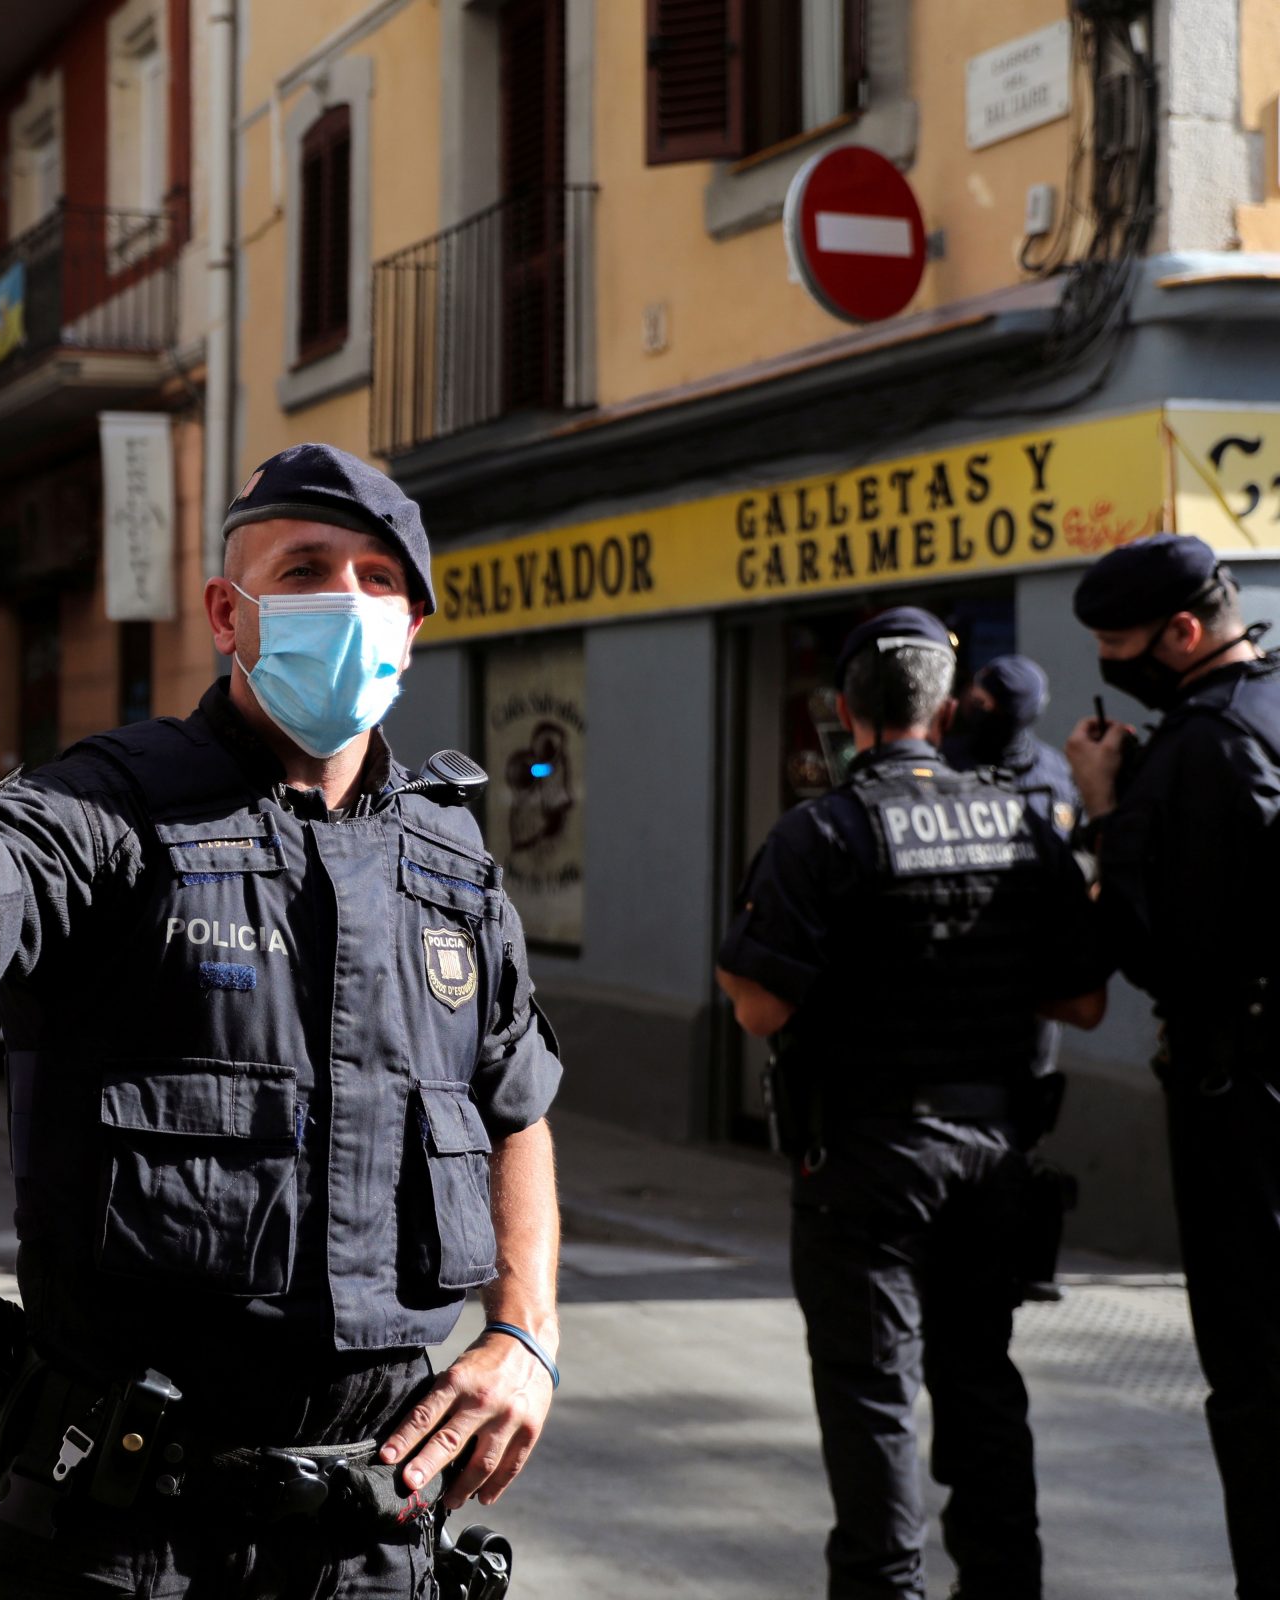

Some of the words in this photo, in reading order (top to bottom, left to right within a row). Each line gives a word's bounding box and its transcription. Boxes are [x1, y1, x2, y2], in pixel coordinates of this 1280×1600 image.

[736, 452, 991, 541] GALLETAS
[1025, 440, 1055, 491] Y
[736, 500, 1056, 590] CARAMELOS
[443, 531, 655, 622] SALVADOR
[885, 799, 1032, 845] POLICIA
[895, 845, 955, 871] MOSSOS
[166, 917, 289, 956] POLICIA
[428, 935, 465, 949] POLICIA
[427, 968, 447, 994] MOSSOS
